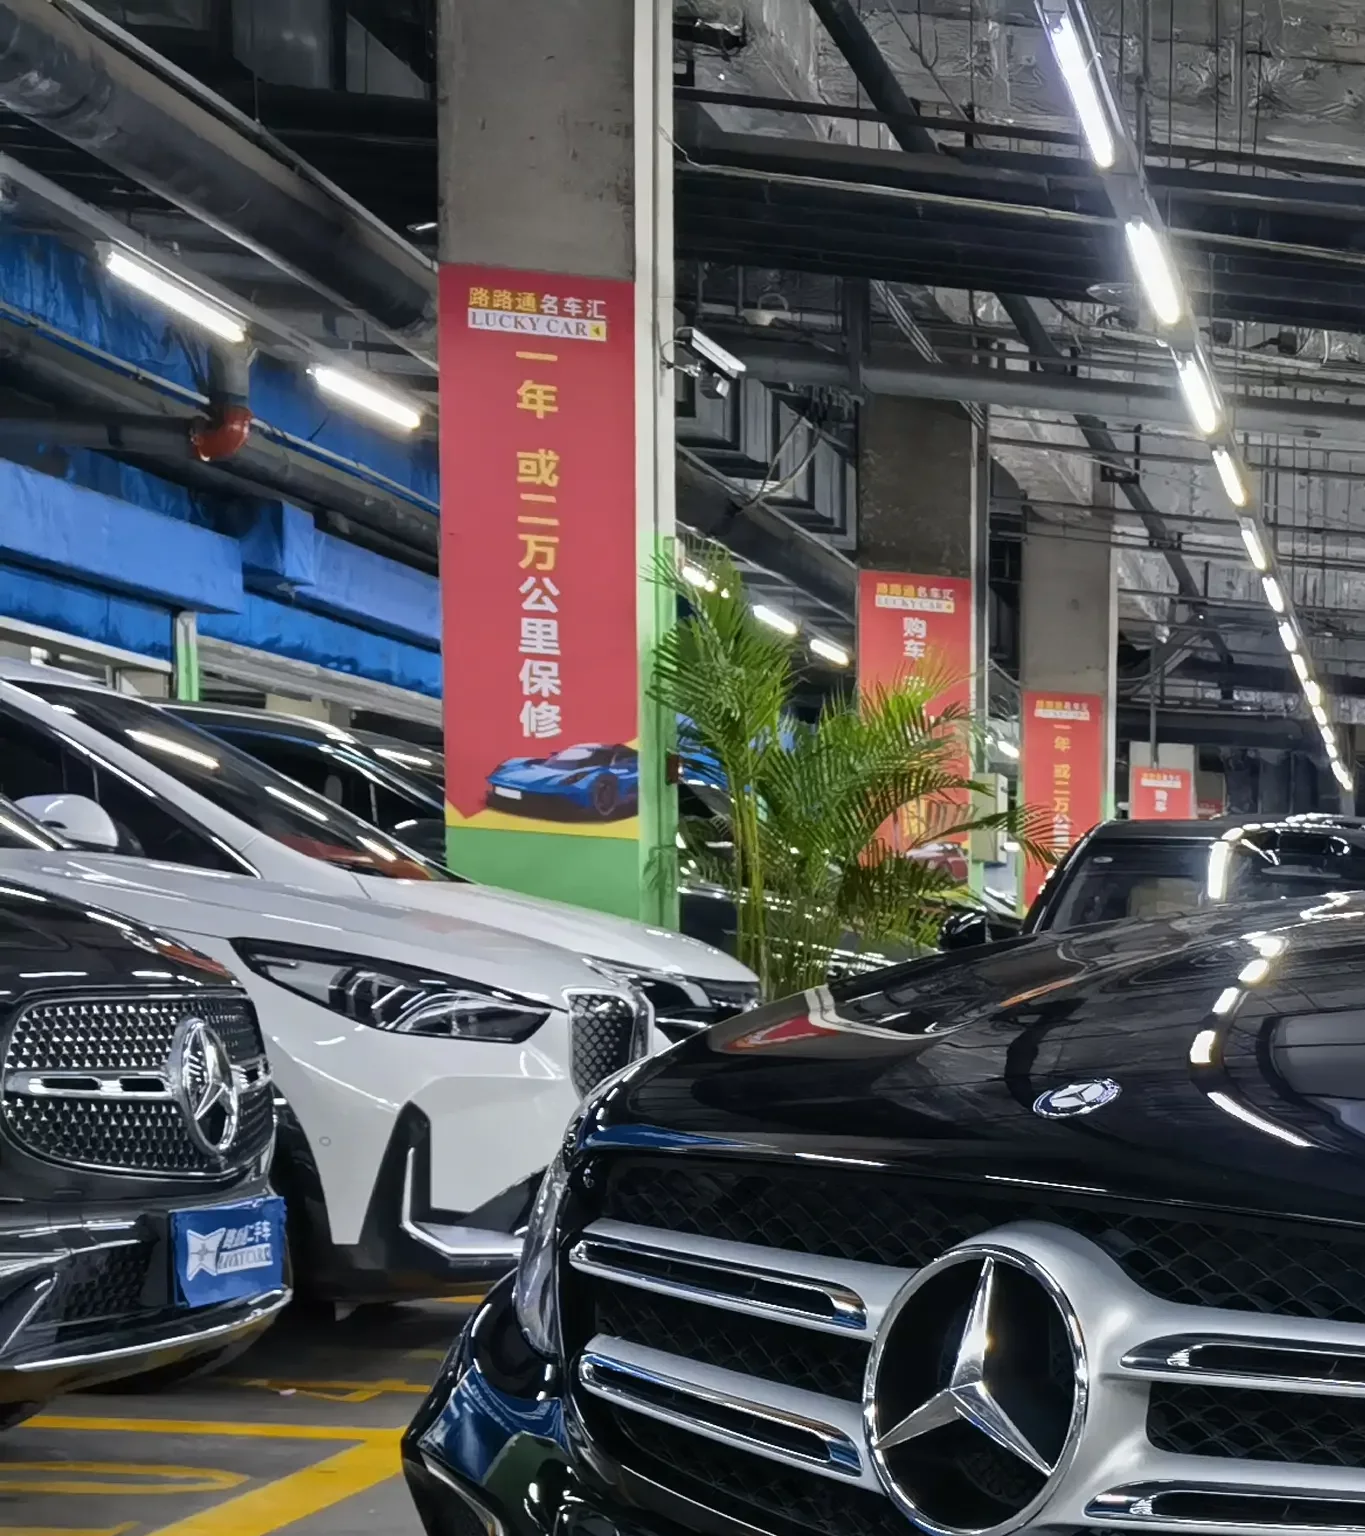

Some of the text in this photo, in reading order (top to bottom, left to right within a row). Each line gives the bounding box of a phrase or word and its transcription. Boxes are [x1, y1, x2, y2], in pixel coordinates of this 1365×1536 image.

[469, 287, 607, 319] 路路通名车汇
[472, 311, 588, 336] LUCKY CAR
[515, 350, 563, 739] 一年 或二万公里保修
